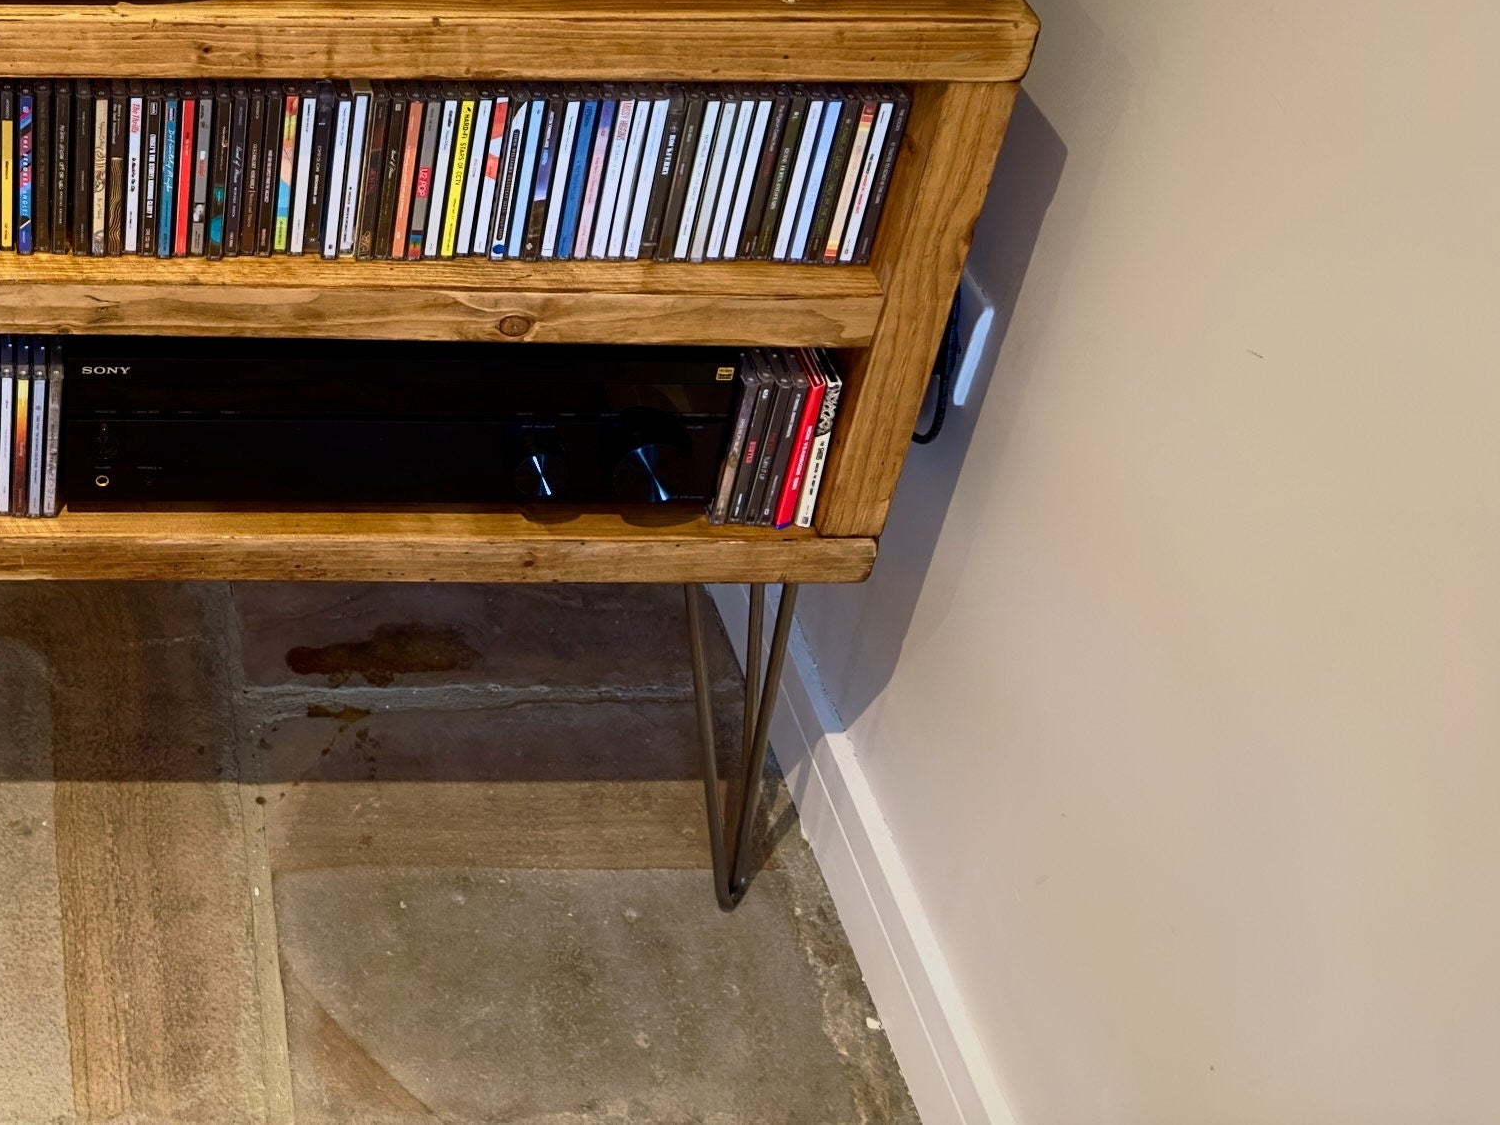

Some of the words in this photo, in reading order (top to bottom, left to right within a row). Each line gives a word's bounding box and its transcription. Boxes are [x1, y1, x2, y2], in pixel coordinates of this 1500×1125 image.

[131, 115, 139, 132] Thrills
[458, 143, 466, 160] STARS
[419, 168, 428, 178] U2
[454, 171, 462, 185] CCTV
[417, 179, 426, 197] POP
[82, 366, 131, 374] SONY
